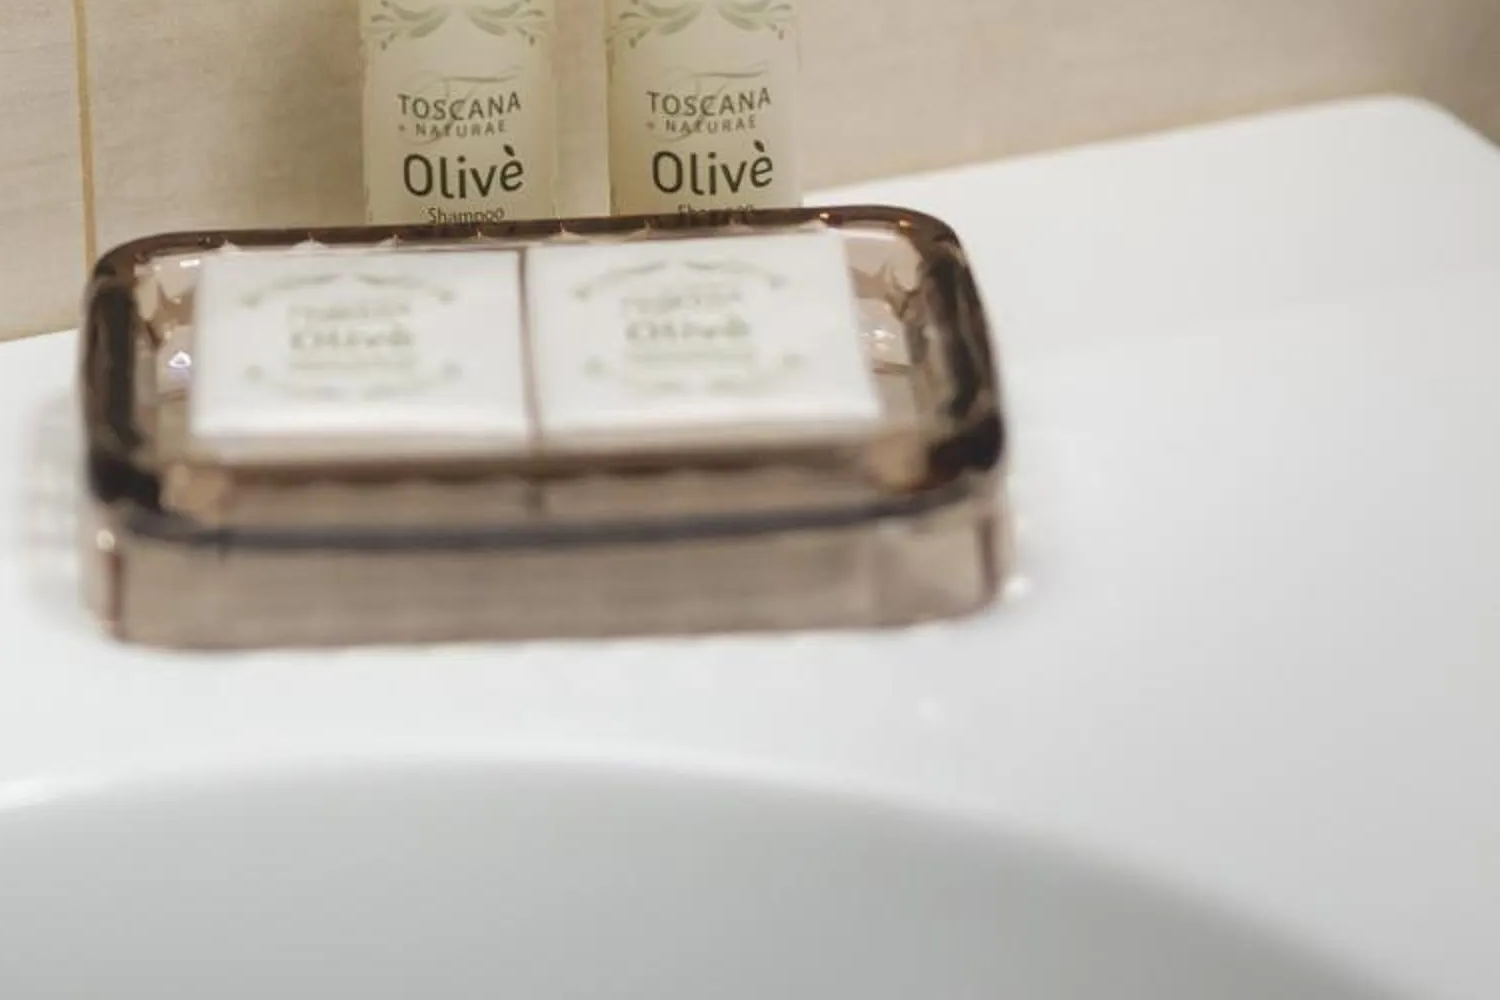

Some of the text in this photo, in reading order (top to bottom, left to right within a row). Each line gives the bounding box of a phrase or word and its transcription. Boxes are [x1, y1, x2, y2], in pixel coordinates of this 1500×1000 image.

[397, 91, 521, 120] TOSCANA
[646, 87, 771, 116] TOSCANA
[415, 119, 506, 137] NATURAE
[665, 114, 757, 134] NATURAE
[403, 145, 524, 199] Olivè
[652, 141, 773, 195] Olivè
[428, 207, 505, 225] Shampoo
